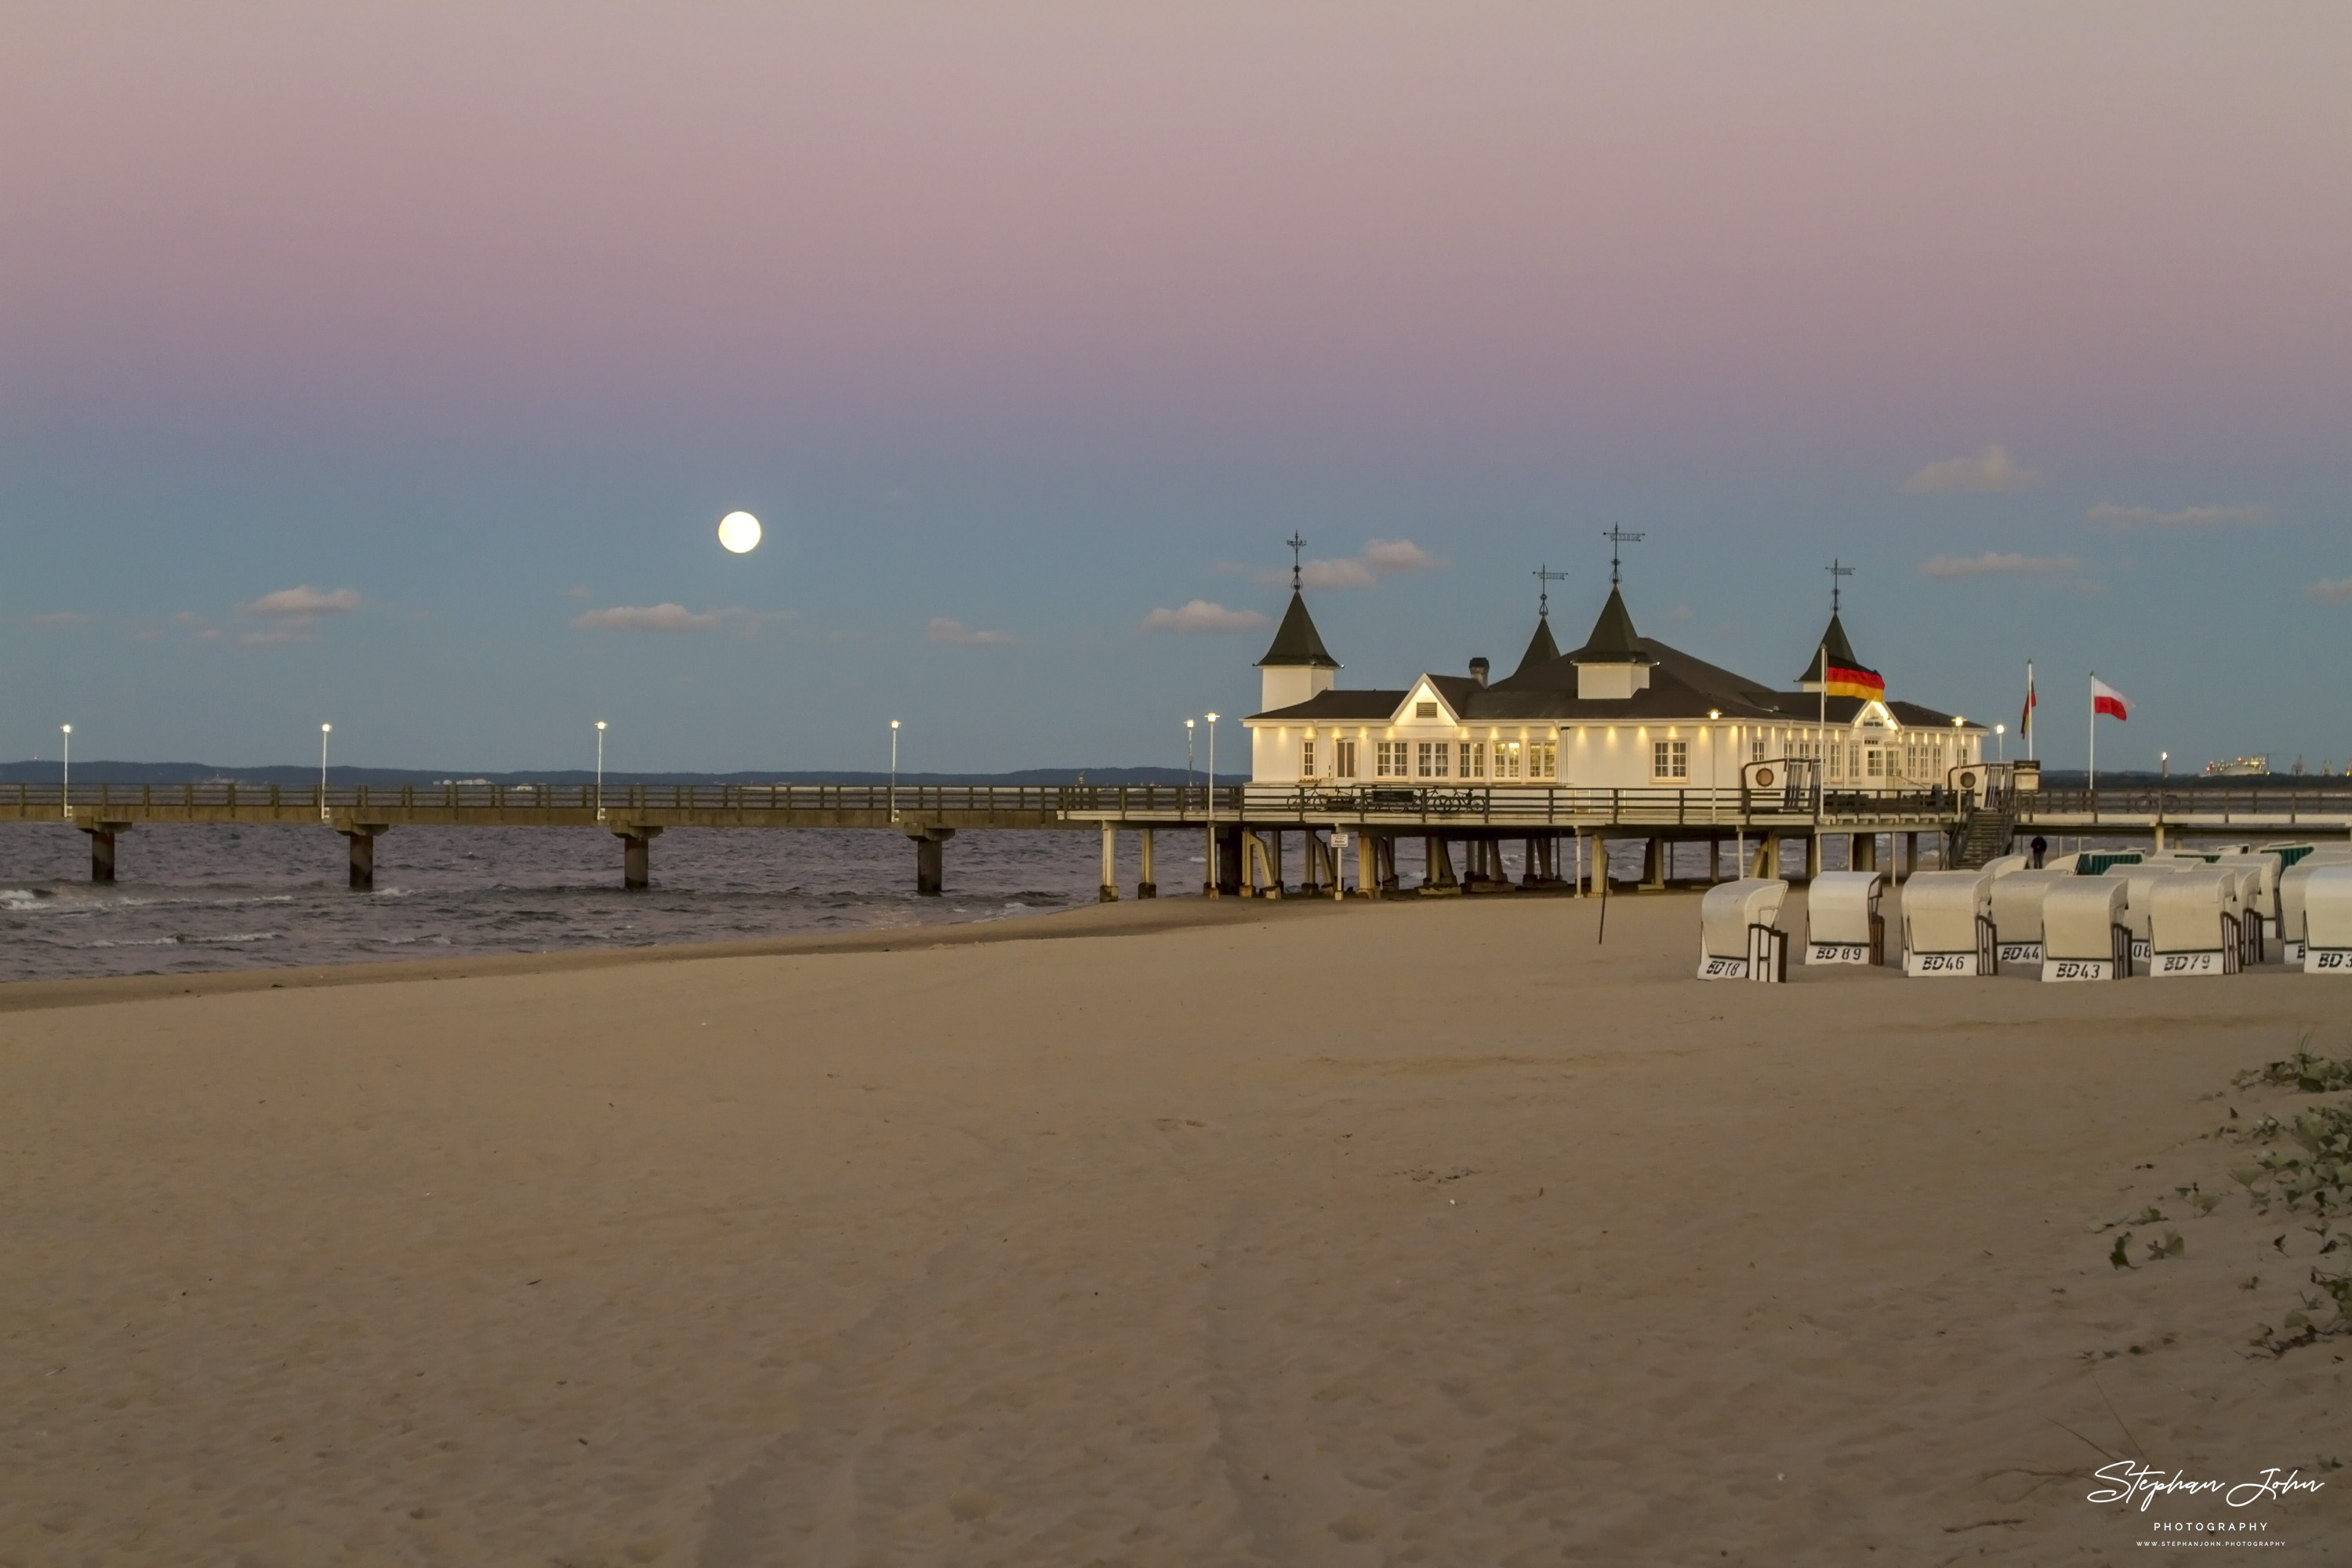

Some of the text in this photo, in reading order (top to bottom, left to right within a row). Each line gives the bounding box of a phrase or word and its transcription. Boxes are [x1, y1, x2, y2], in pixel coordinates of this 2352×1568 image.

[2002, 946, 2039, 960] BD44
[1922, 956, 1965, 971] BD46
[2056, 963, 2100, 979] BD43
[2164, 955, 2210, 972] BD79
